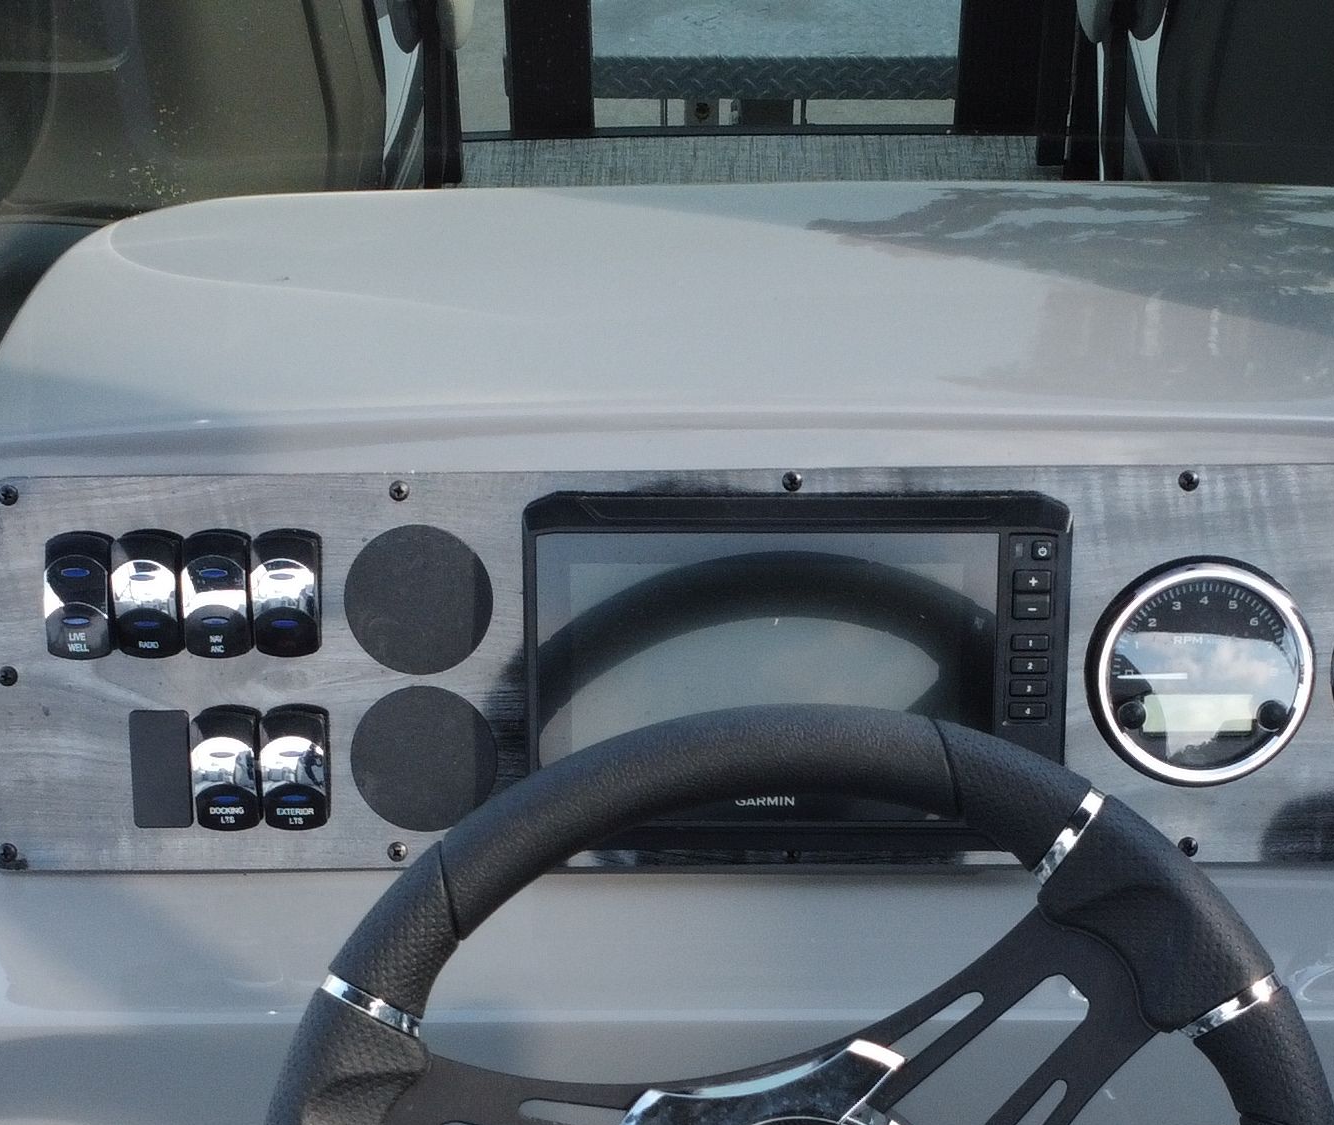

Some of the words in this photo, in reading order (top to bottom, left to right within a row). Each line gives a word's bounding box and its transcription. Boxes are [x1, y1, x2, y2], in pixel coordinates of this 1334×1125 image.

[1199, 596, 1209, 605] 4
[1229, 600, 1238, 609] 5
[1172, 601, 1181, 610] 3
[1148, 618, 1157, 627] 2
[1250, 617, 1259, 626] 6
[69, 632, 86, 641] LIVE
[1174, 636, 1203, 645] RPM
[68, 643, 89, 652] WELL
[138, 641, 159, 649] RADIO
[735, 796, 795, 807] GARMIN
[209, 807, 245, 815] DOCKING
[276, 808, 315, 816] EXTERIOR
[221, 816, 236, 824] LTS
[289, 817, 304, 825] LTS
